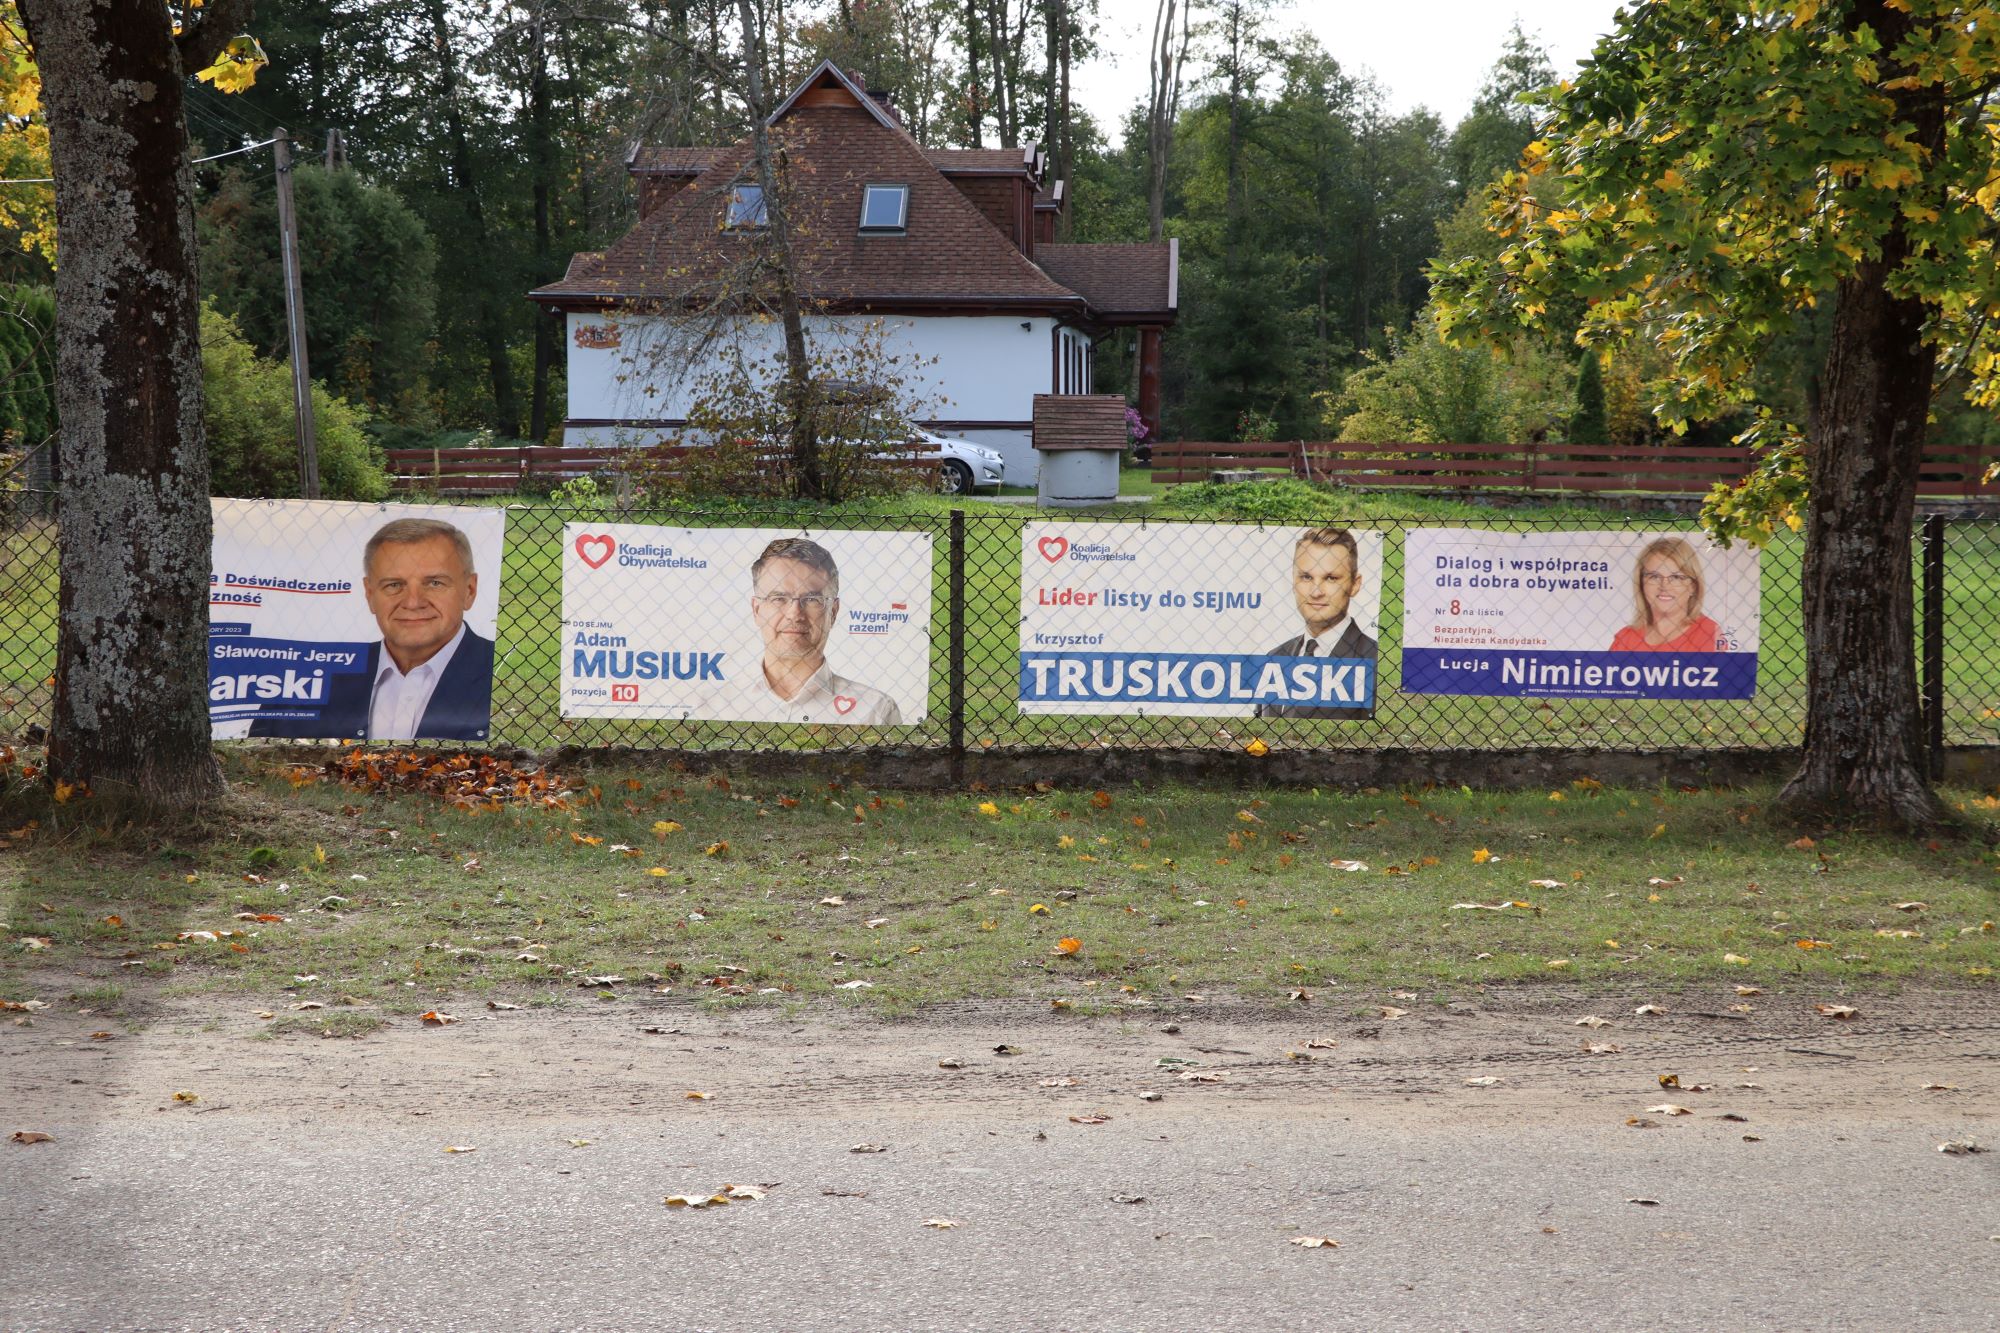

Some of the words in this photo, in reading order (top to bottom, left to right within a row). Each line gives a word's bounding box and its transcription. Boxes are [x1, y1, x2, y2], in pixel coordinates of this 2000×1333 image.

[618, 543, 672, 557] Koalicja
[1070, 543, 1111, 554] Koalicja
[618, 556, 707, 569] Obywatelska
[1070, 552, 1136, 563] Obywatelska
[1436, 556, 1492, 572] Dialog
[1499, 558, 1504, 571] i
[1511, 557, 1608, 574] współpraca
[225, 573, 352, 592] Doświadczenie
[1436, 574, 1461, 588] dla
[1469, 575, 1519, 589] dobra
[1526, 574, 1614, 592] obywateli.
[1038, 588, 1097, 606] Lider
[1103, 589, 1152, 612] listy
[1159, 590, 1187, 608] do
[1192, 591, 1262, 612] SEJMU
[1435, 608, 1446, 616] Nr
[1450, 600, 1460, 616] 8
[1478, 608, 1504, 617] liście
[849, 610, 908, 624] Wygrajmy
[586, 621, 613, 629] SEJMU
[849, 623, 889, 632] razem!
[574, 631, 627, 648] Adam
[1035, 633, 1104, 647] Krzysztof
[1489, 636, 1547, 646] Kandydatka
[214, 645, 301, 661] Sławomir
[304, 650, 356, 666] Jerzy
[573, 649, 725, 681] MUSIUK
[1502, 658, 1719, 687] Nimierowicz
[1028, 659, 1366, 702] TRUSKOLASKI
[571, 687, 607, 697] pozycja
[614, 686, 636, 700] 10
